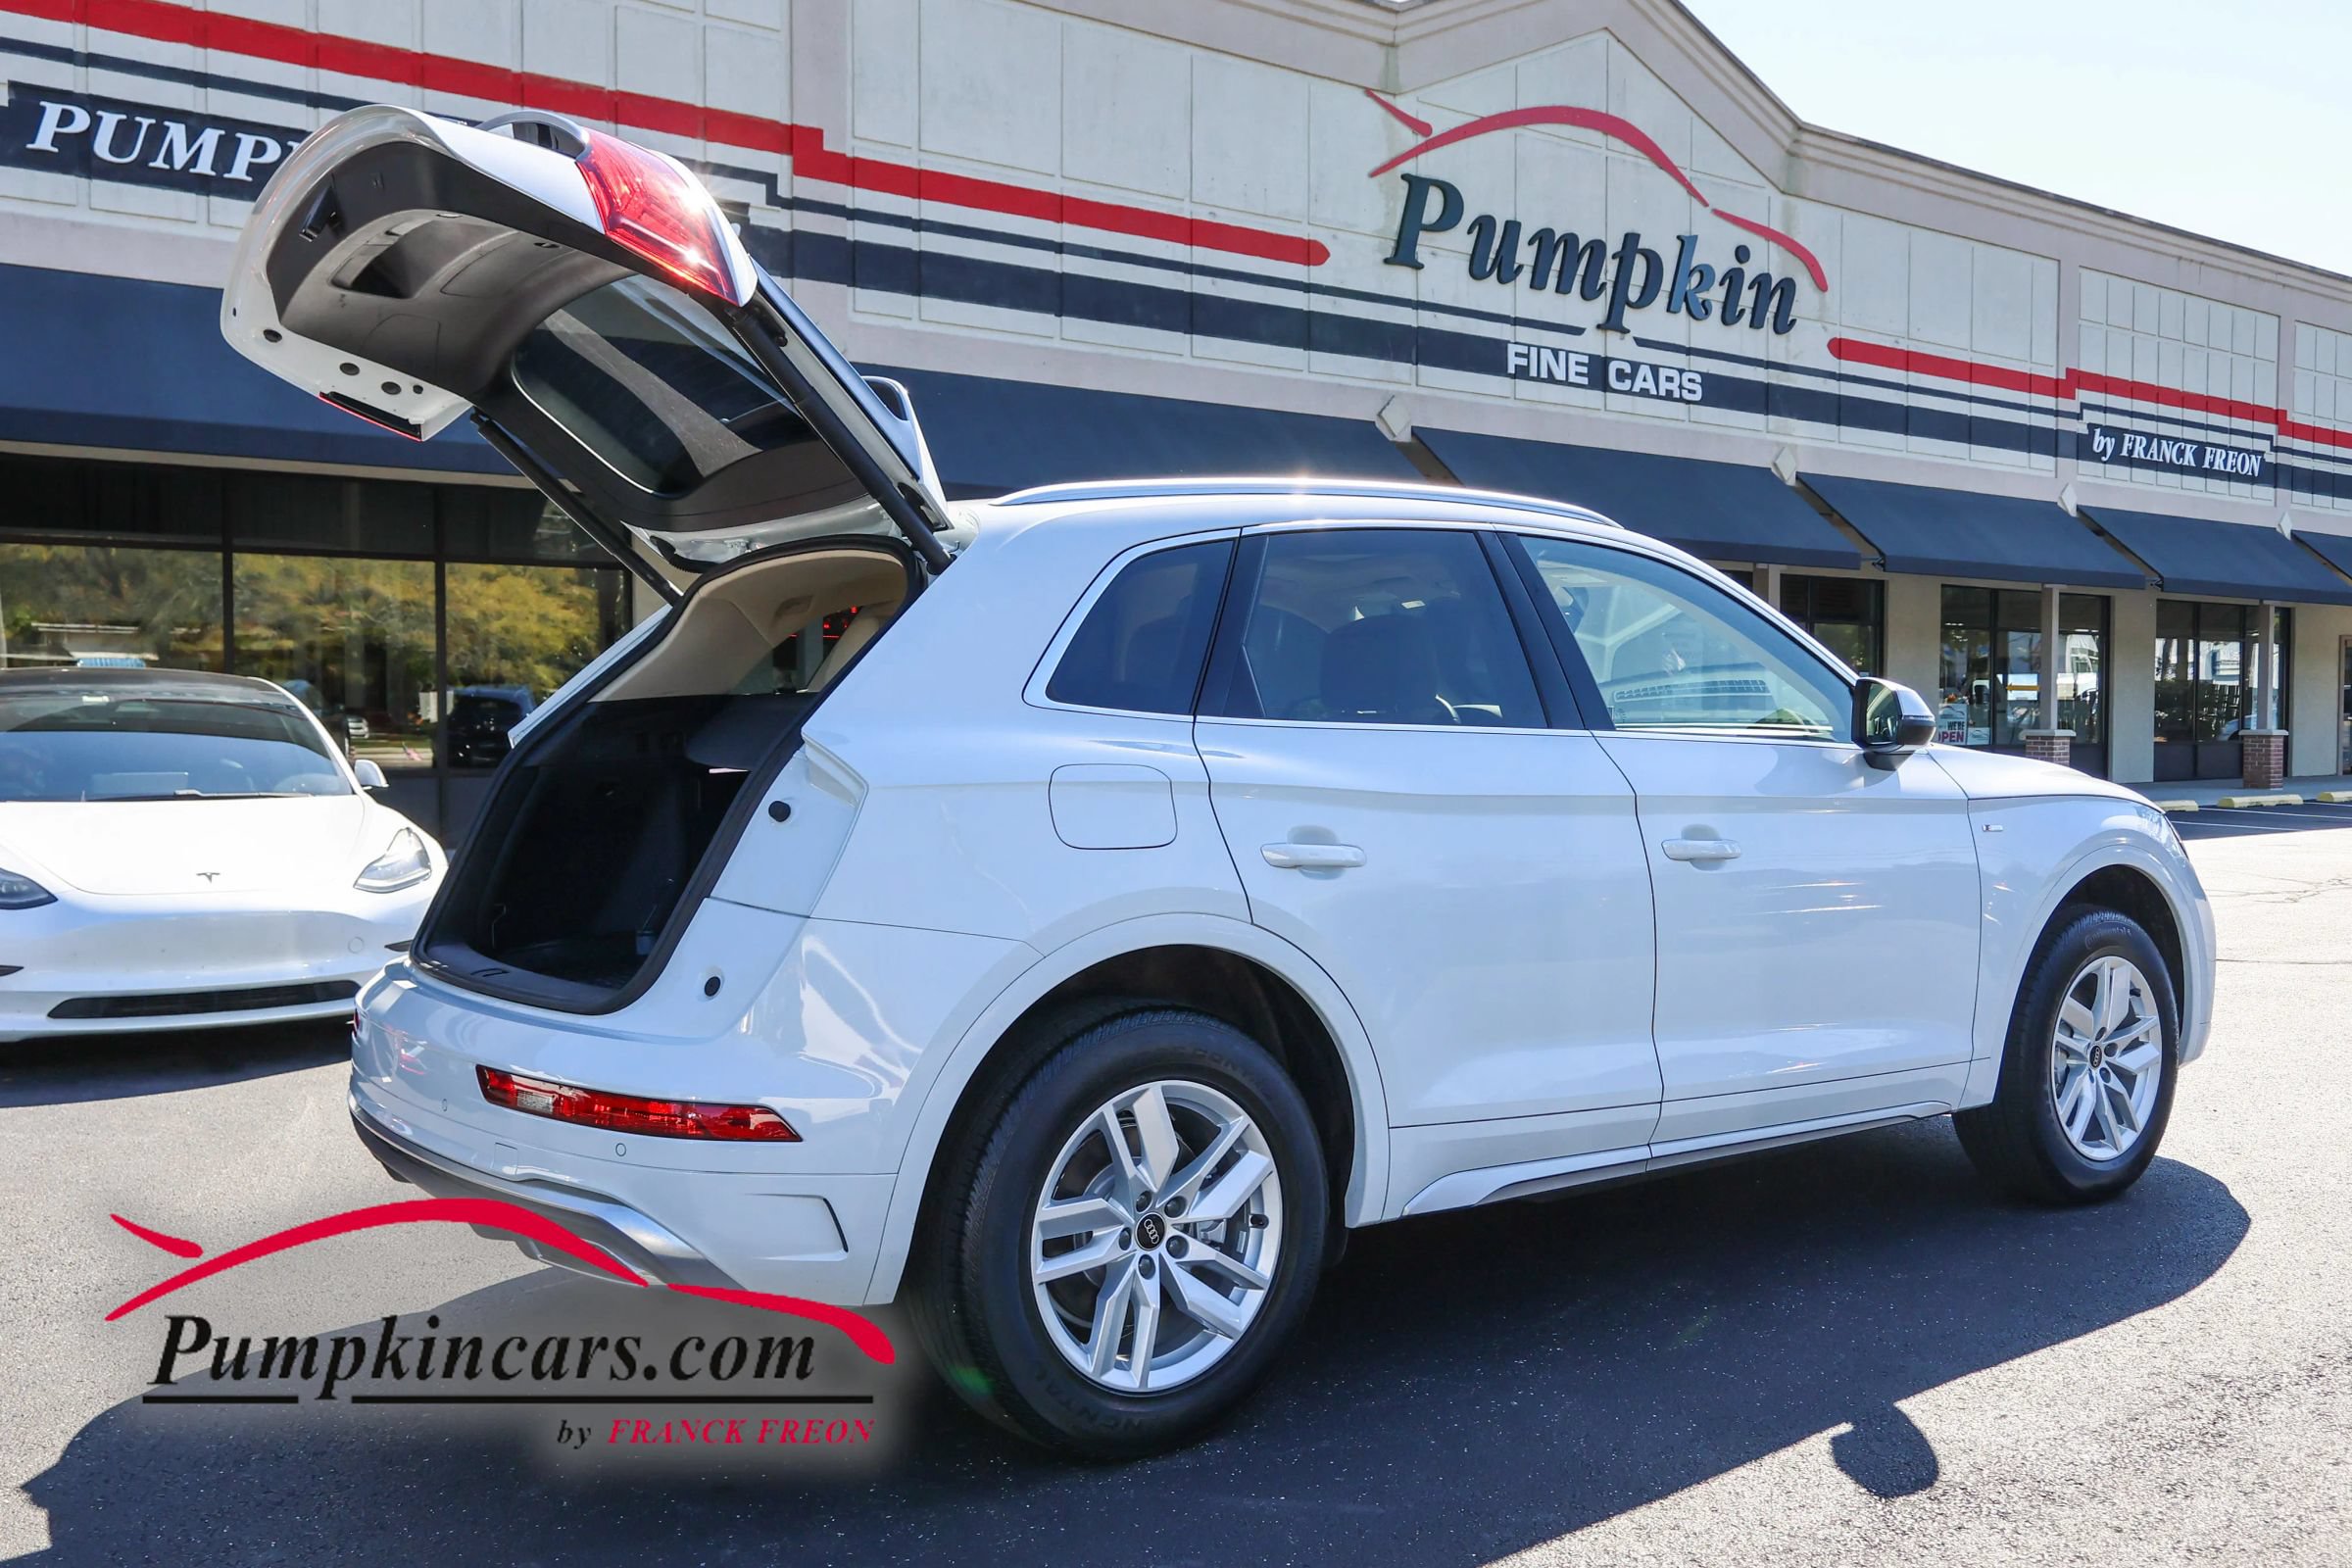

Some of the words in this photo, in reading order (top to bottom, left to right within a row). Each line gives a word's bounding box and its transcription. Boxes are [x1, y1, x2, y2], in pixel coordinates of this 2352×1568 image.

[25, 100, 302, 182] PUMP
[1384, 172, 1797, 335] Pumpkin
[1506, 343, 1590, 386] FINE
[1607, 360, 1702, 402] CARS
[2092, 427, 2115, 462] by
[2120, 433, 2198, 467] FRANCK
[2202, 446, 2263, 477] FREON
